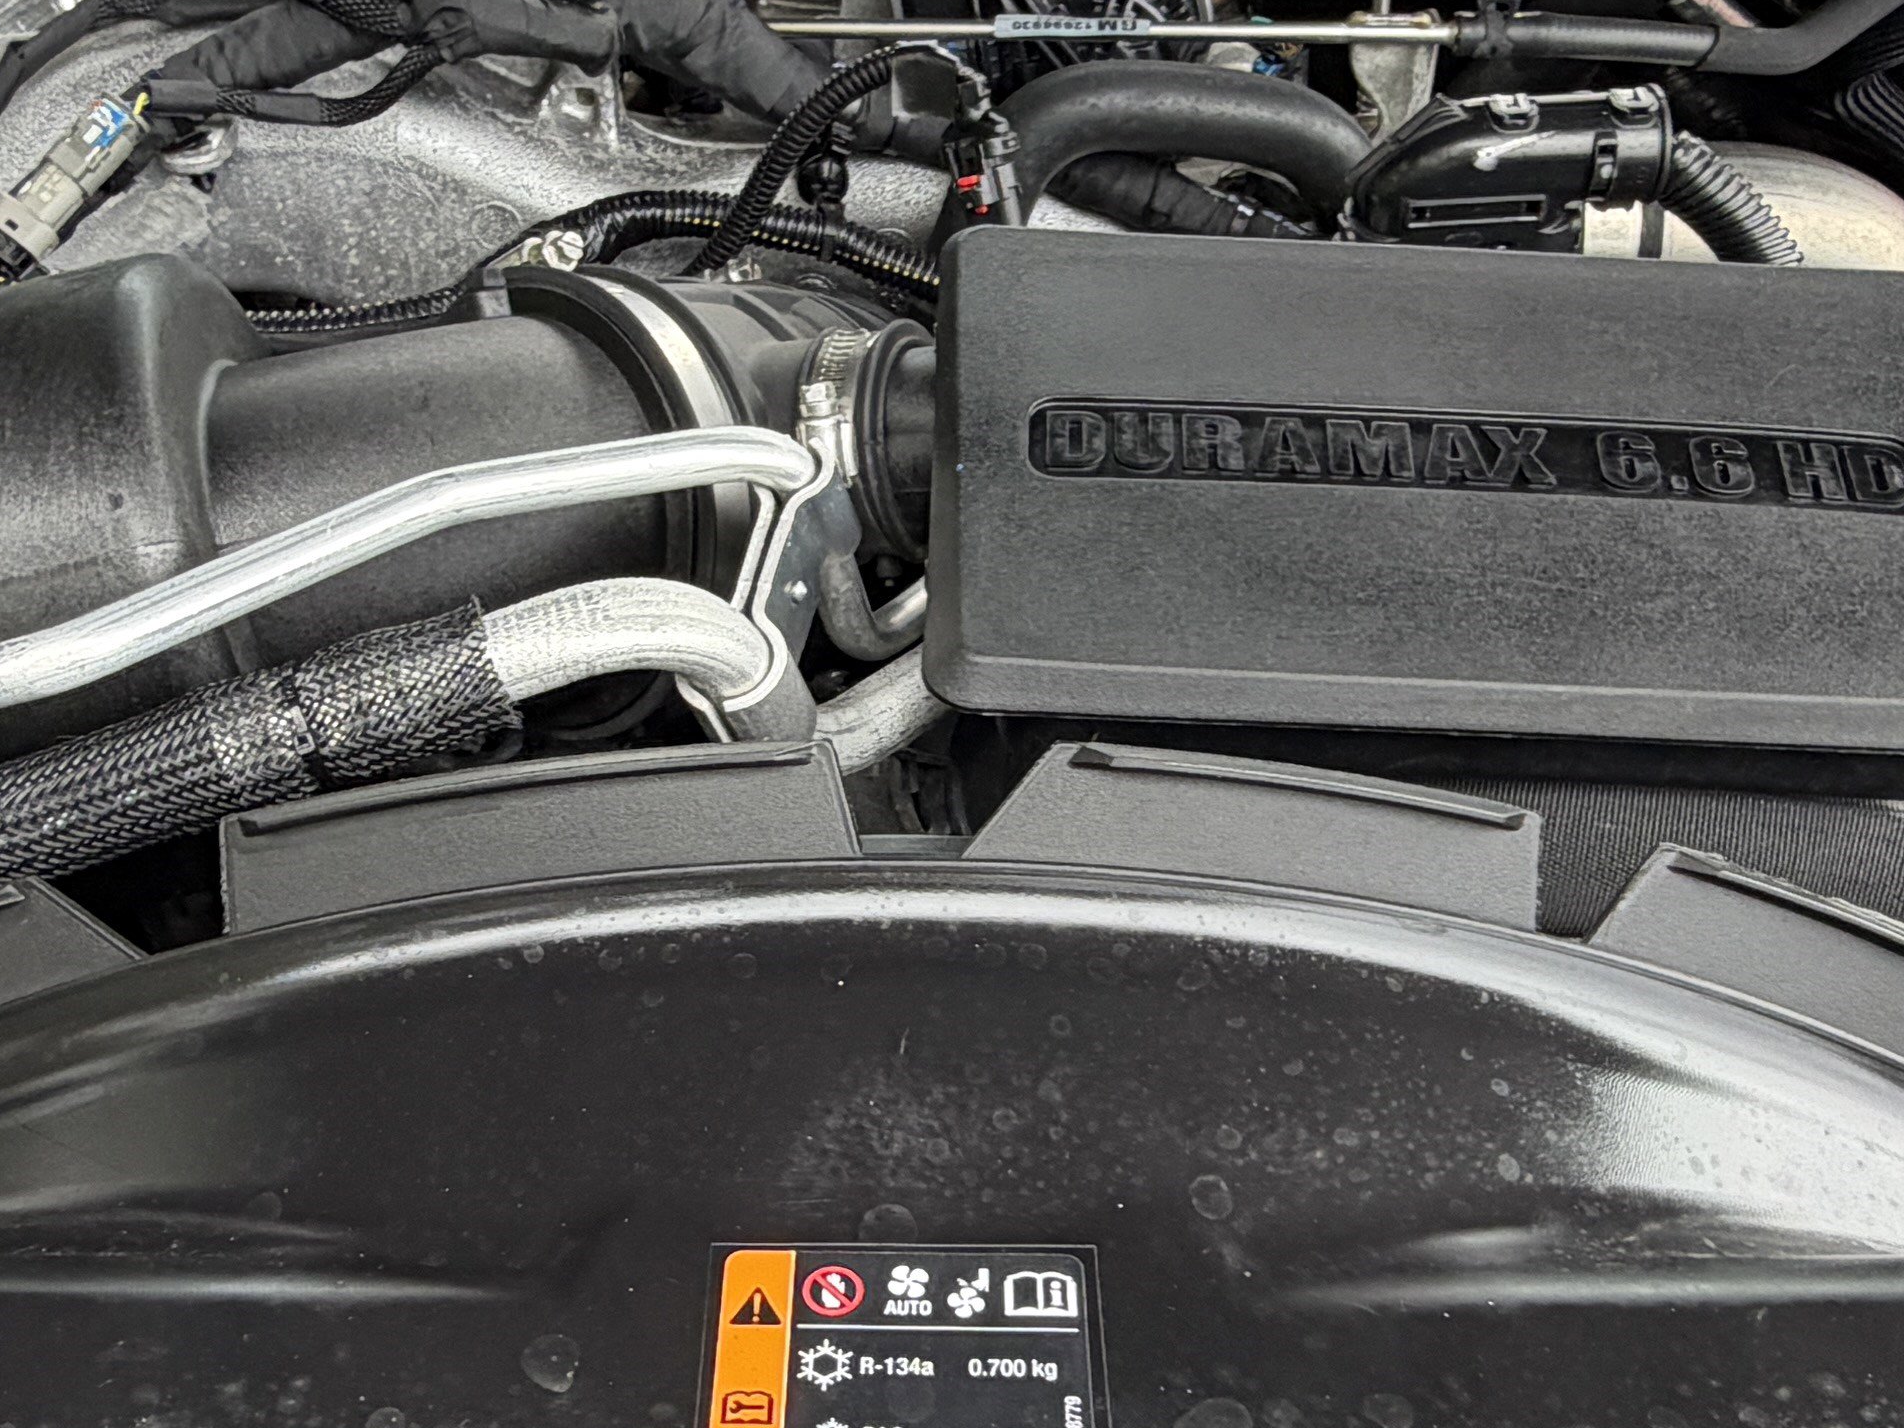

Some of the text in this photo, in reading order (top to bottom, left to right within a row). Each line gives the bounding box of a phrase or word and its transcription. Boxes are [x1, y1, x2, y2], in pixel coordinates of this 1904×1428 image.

[1097, 21, 1138, 32] GM
[1043, 408, 1559, 489] DURAMAX
[1595, 430, 1757, 494] 6.6
[883, 1298, 933, 1317] AUTO
[858, 1357, 1059, 1382] R-134a 0.700 kg
